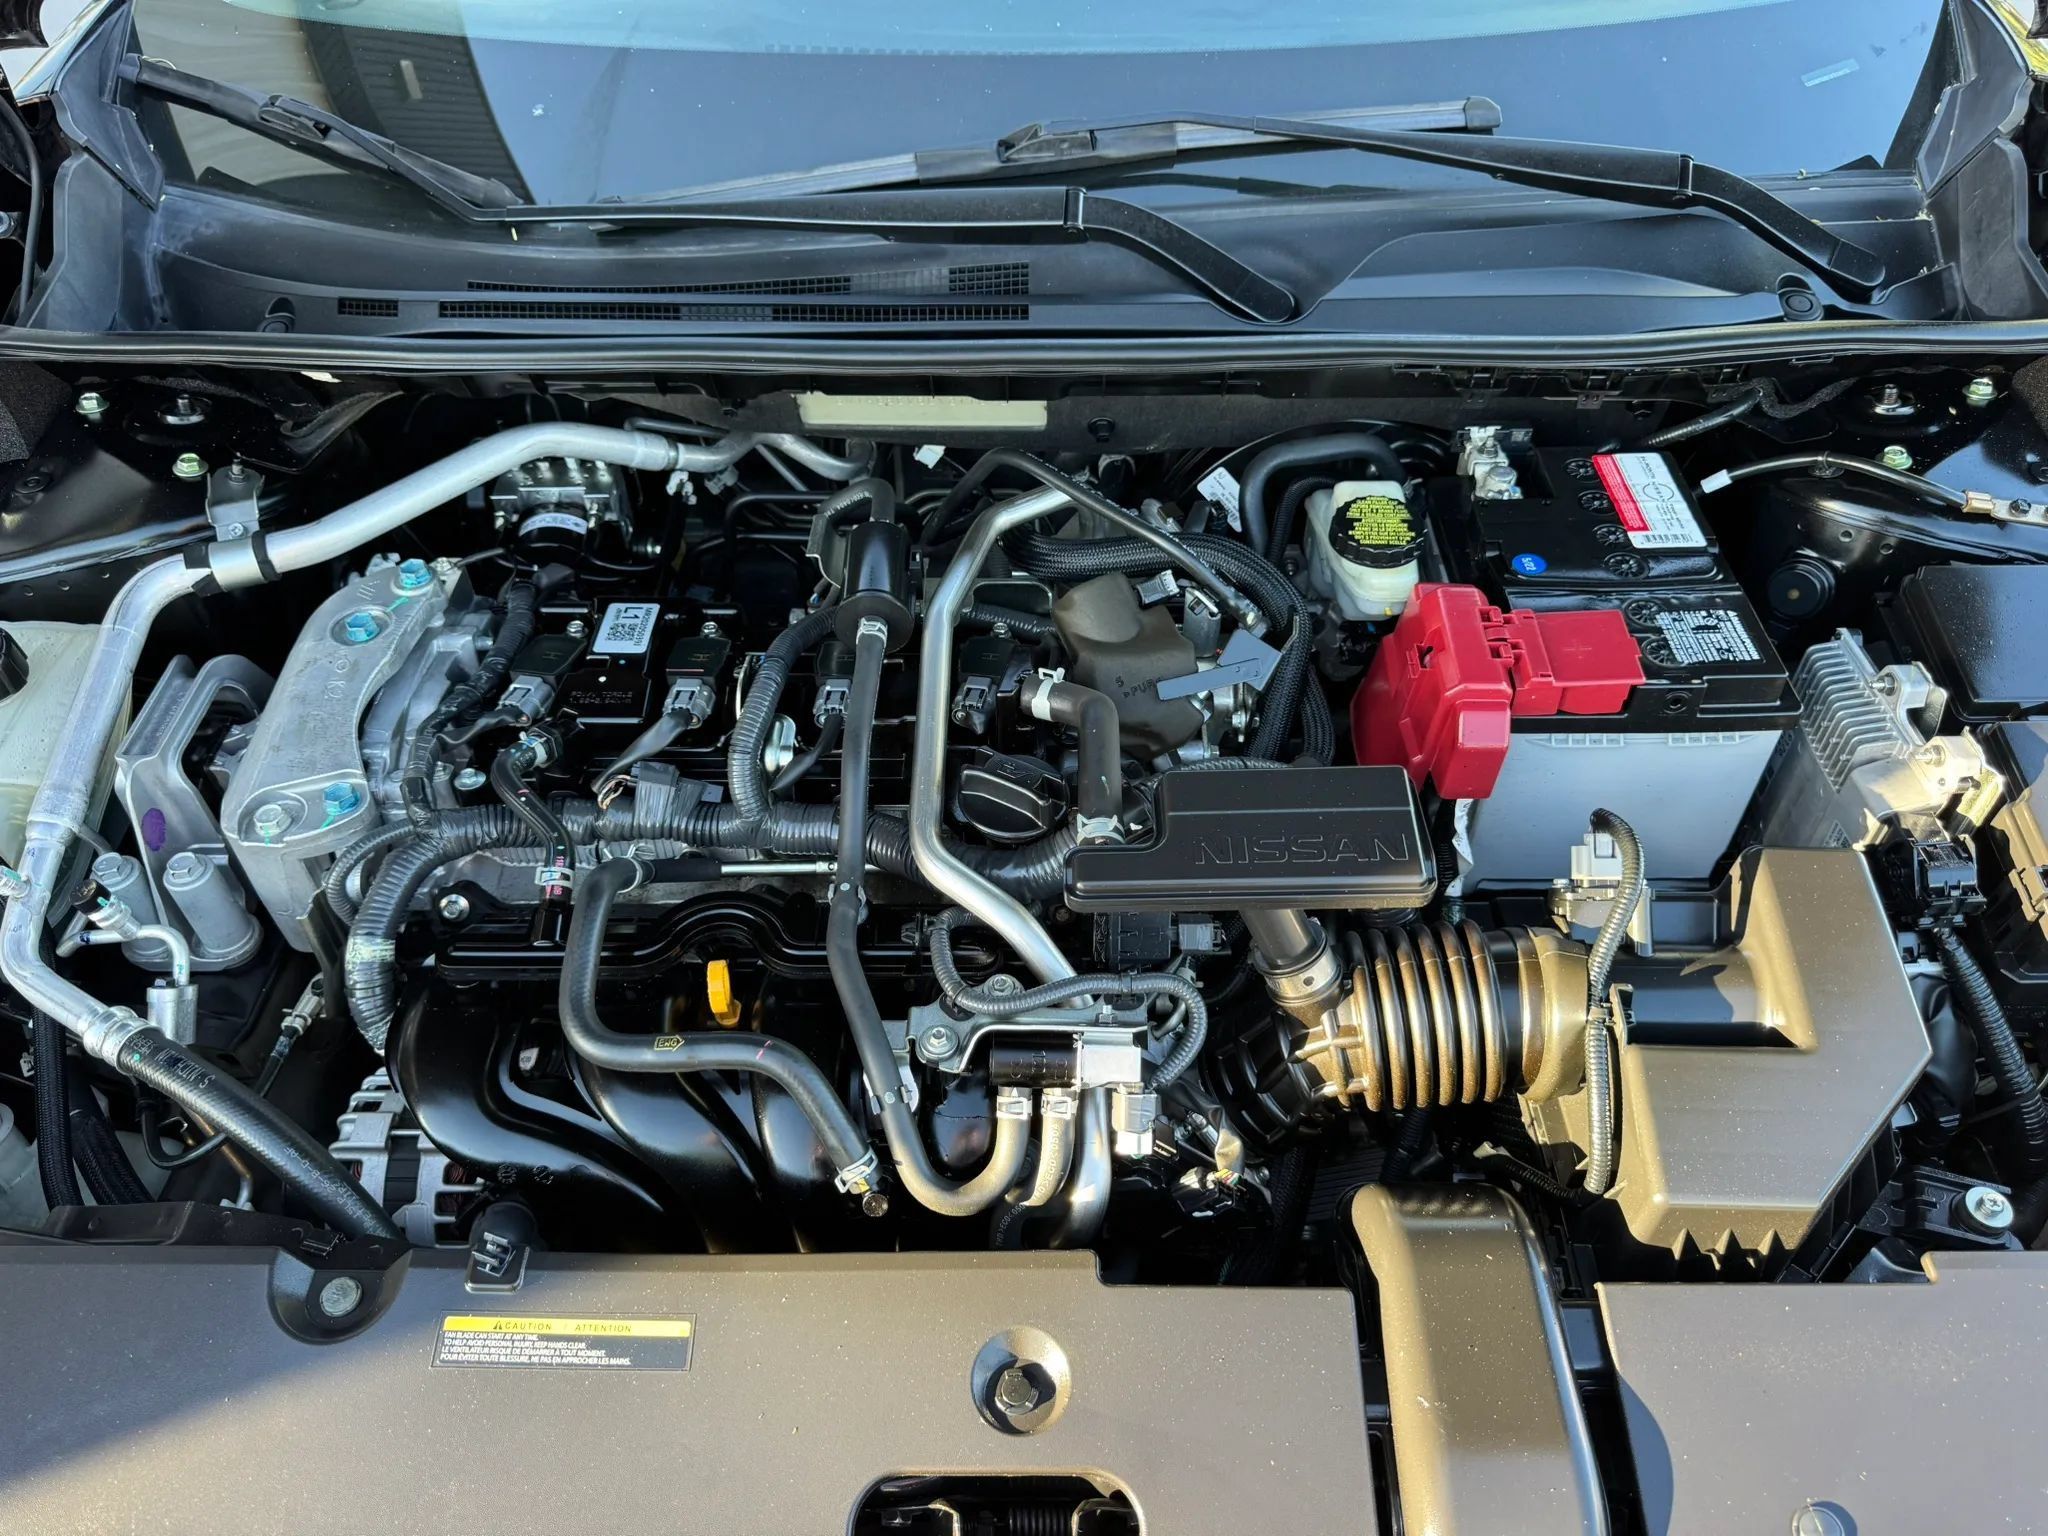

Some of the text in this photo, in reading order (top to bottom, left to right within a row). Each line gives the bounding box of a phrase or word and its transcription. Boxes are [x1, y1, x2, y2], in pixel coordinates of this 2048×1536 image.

[1195, 833, 1409, 864] NISSAN
[658, 1038, 678, 1047] ENG
[505, 1322, 632, 1333] CAUTION ATTENTION
[562, 1356, 598, 1364] APPROCHER
